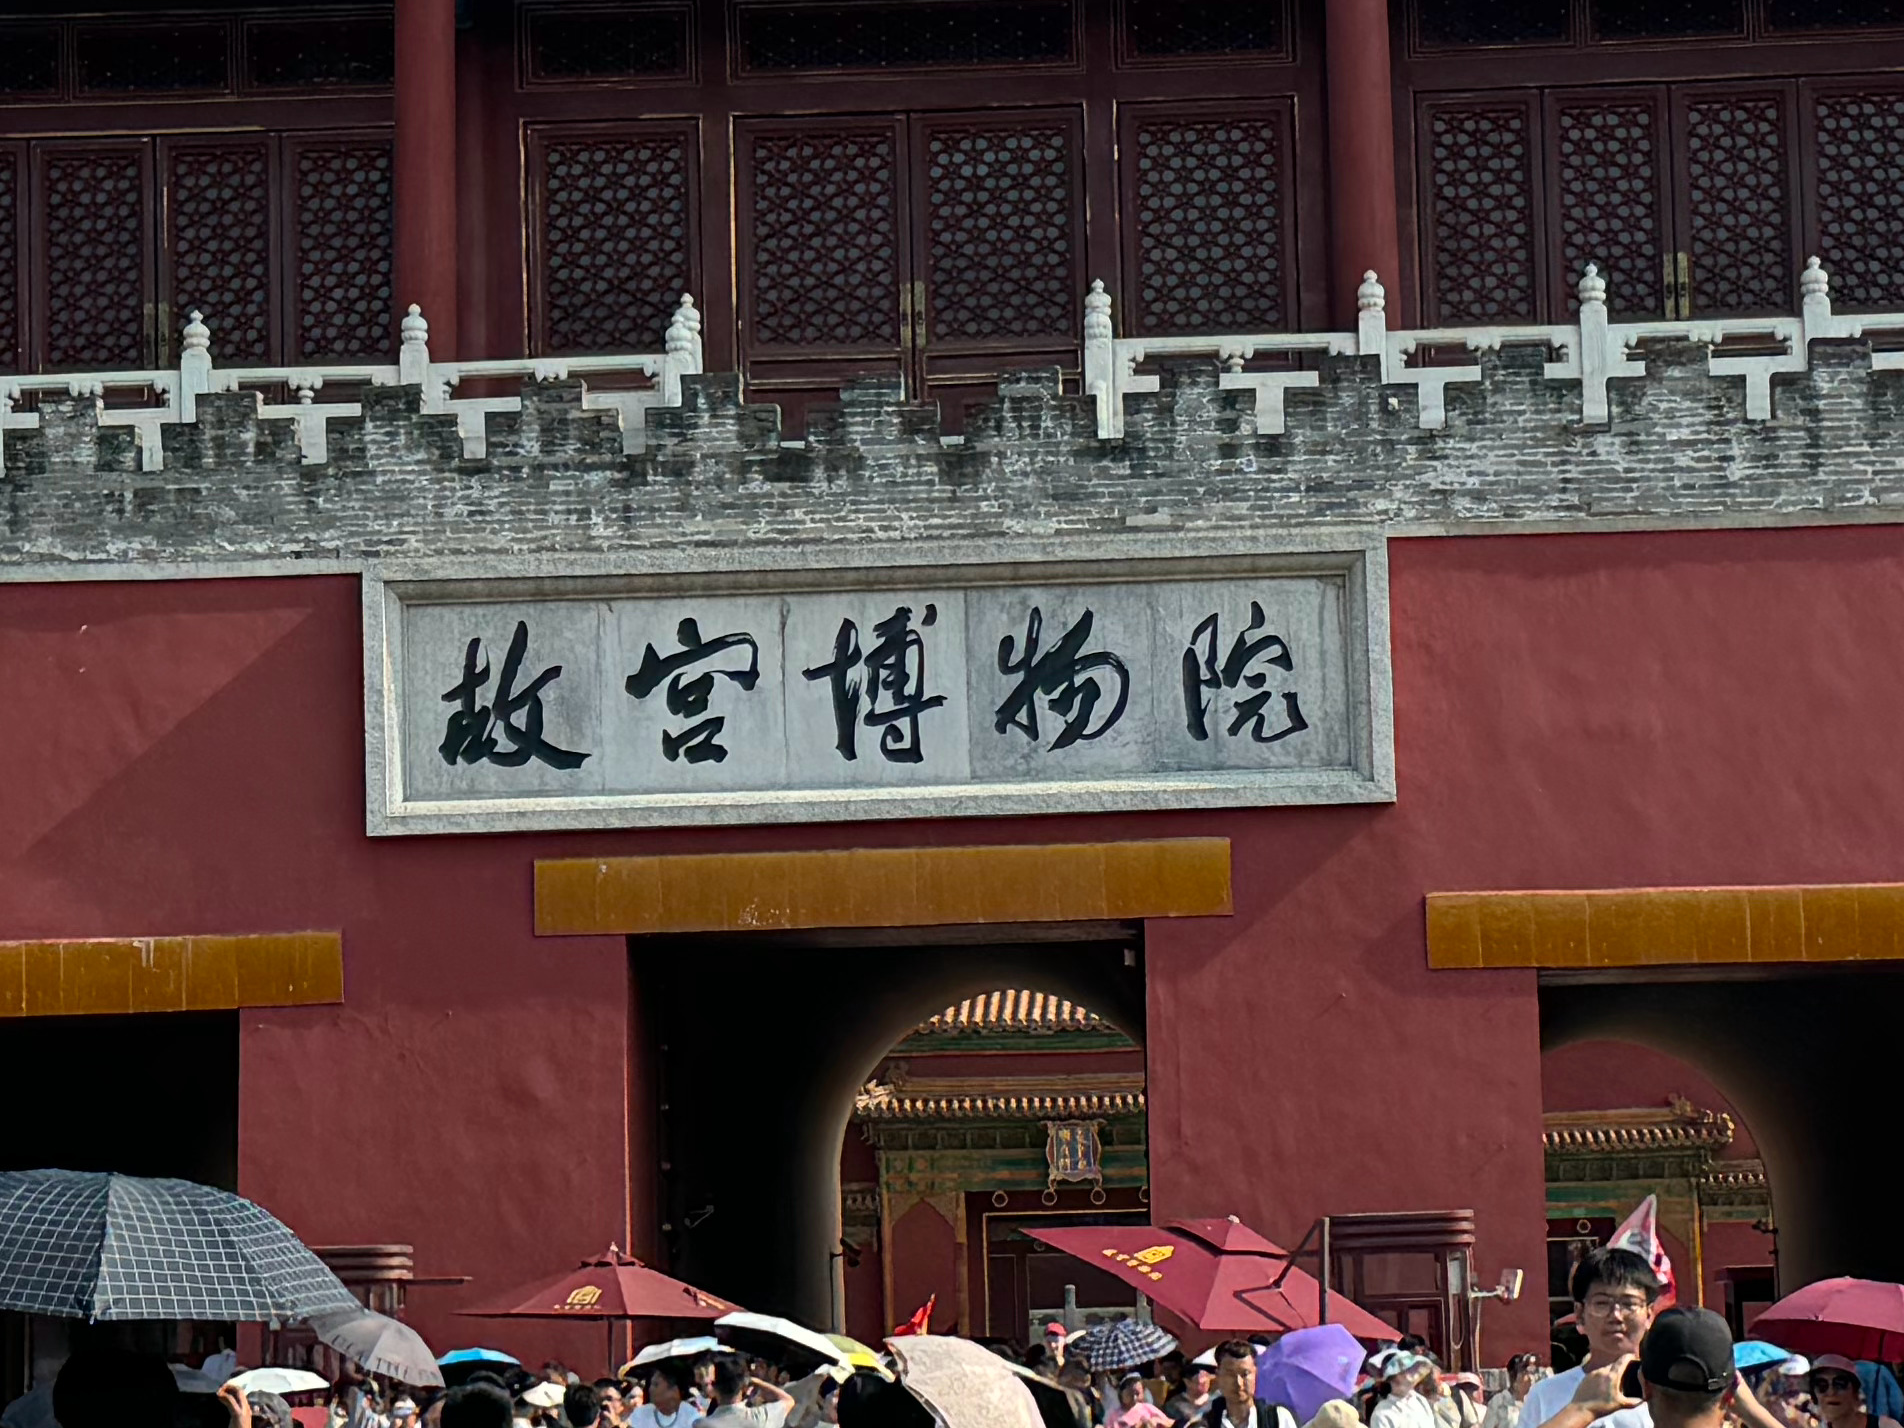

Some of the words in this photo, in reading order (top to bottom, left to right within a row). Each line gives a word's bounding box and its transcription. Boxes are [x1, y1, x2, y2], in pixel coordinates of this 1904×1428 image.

[437, 602, 1310, 772] 故宫博物院
